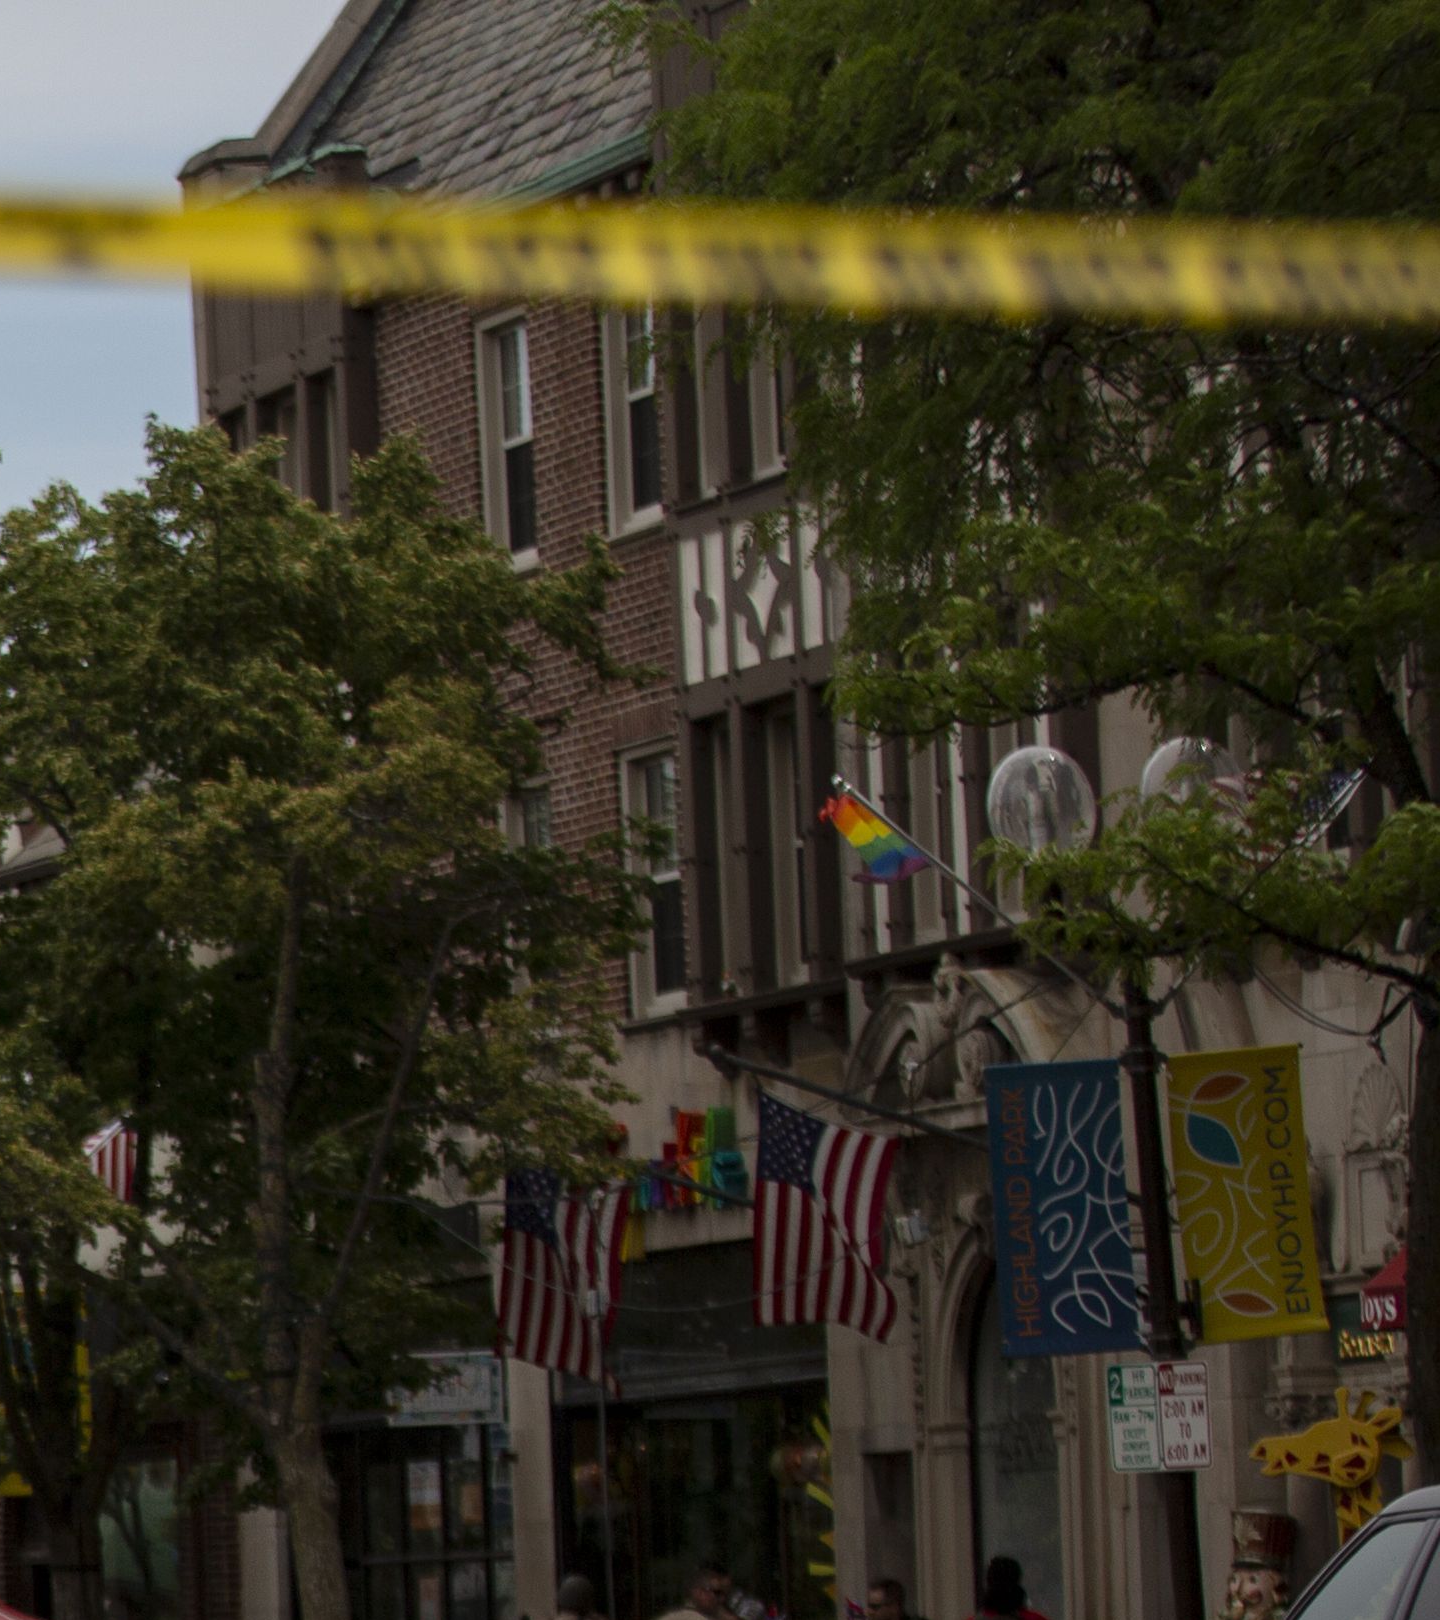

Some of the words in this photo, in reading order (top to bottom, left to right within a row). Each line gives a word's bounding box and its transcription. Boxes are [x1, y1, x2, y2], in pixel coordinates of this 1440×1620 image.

[1000, 1087, 1028, 1166] PARK
[1262, 1064, 1311, 1315] ENJOYHP.COM
[1005, 1175, 1042, 1338] HIGHLAND
[1110, 1373, 1122, 1400] 2
